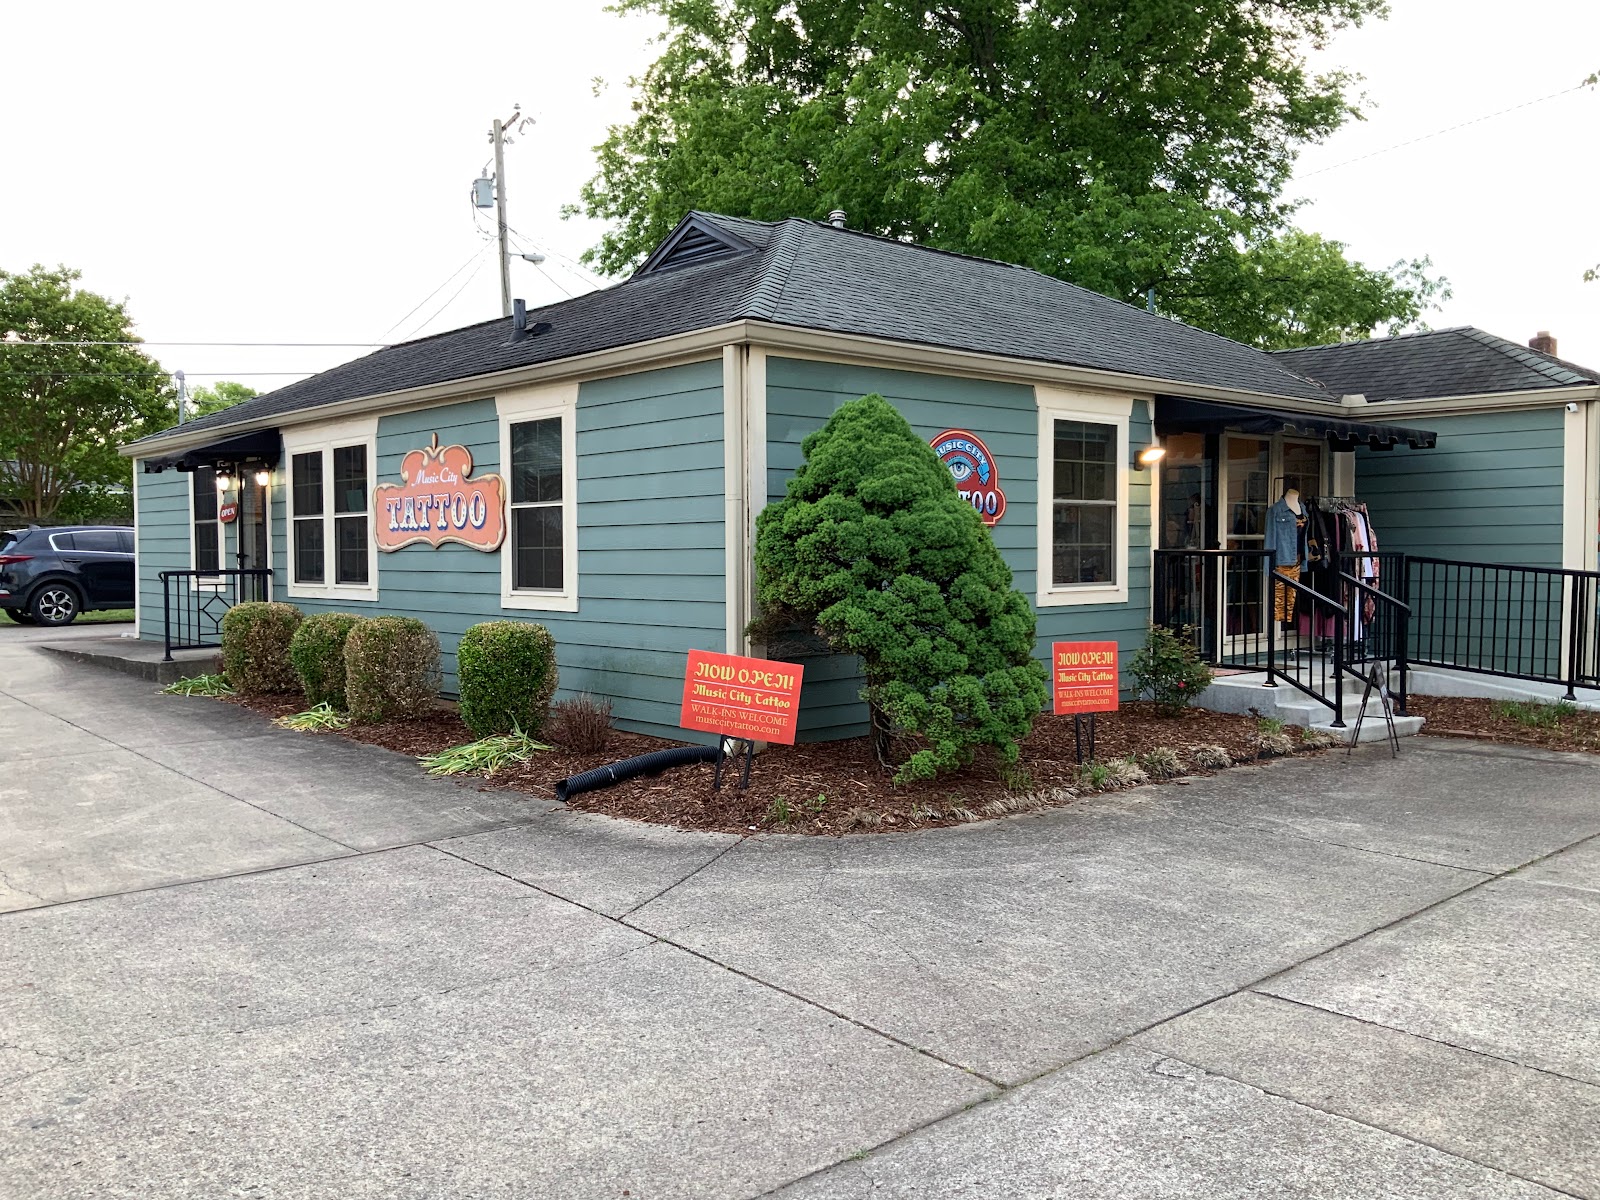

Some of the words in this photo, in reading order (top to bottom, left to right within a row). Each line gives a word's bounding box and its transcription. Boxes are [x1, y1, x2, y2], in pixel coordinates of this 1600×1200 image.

[965, 443, 987, 464] CITY
[411, 469, 439, 487] Music
[440, 467, 458, 486] City
[221, 507, 236, 518] OPEN
[386, 490, 488, 532] TATTOO
[957, 490, 998, 515] TOO
[1058, 651, 1080, 666] NOW
[1081, 651, 1114, 665] OPEN!
[694, 662, 736, 681] NOW
[738, 668, 795, 690] OPEN!
[1058, 672, 1078, 683] Music
[1078, 671, 1091, 684] City
[1092, 671, 1114, 681] Tattoo
[692, 684, 728, 699] Music
[729, 689, 752, 705] City
[755, 692, 791, 709] Tattoo
[1058, 690, 1084, 699] WALK-INS
[1084, 688, 1114, 698] WELCOME
[1061, 698, 1110, 708] musiccitytattoo.com
[691, 703, 737, 718] WALK-INS
[739, 711, 788, 726] WELCOME
[695, 715, 780, 735] musiccitytattoo.com
